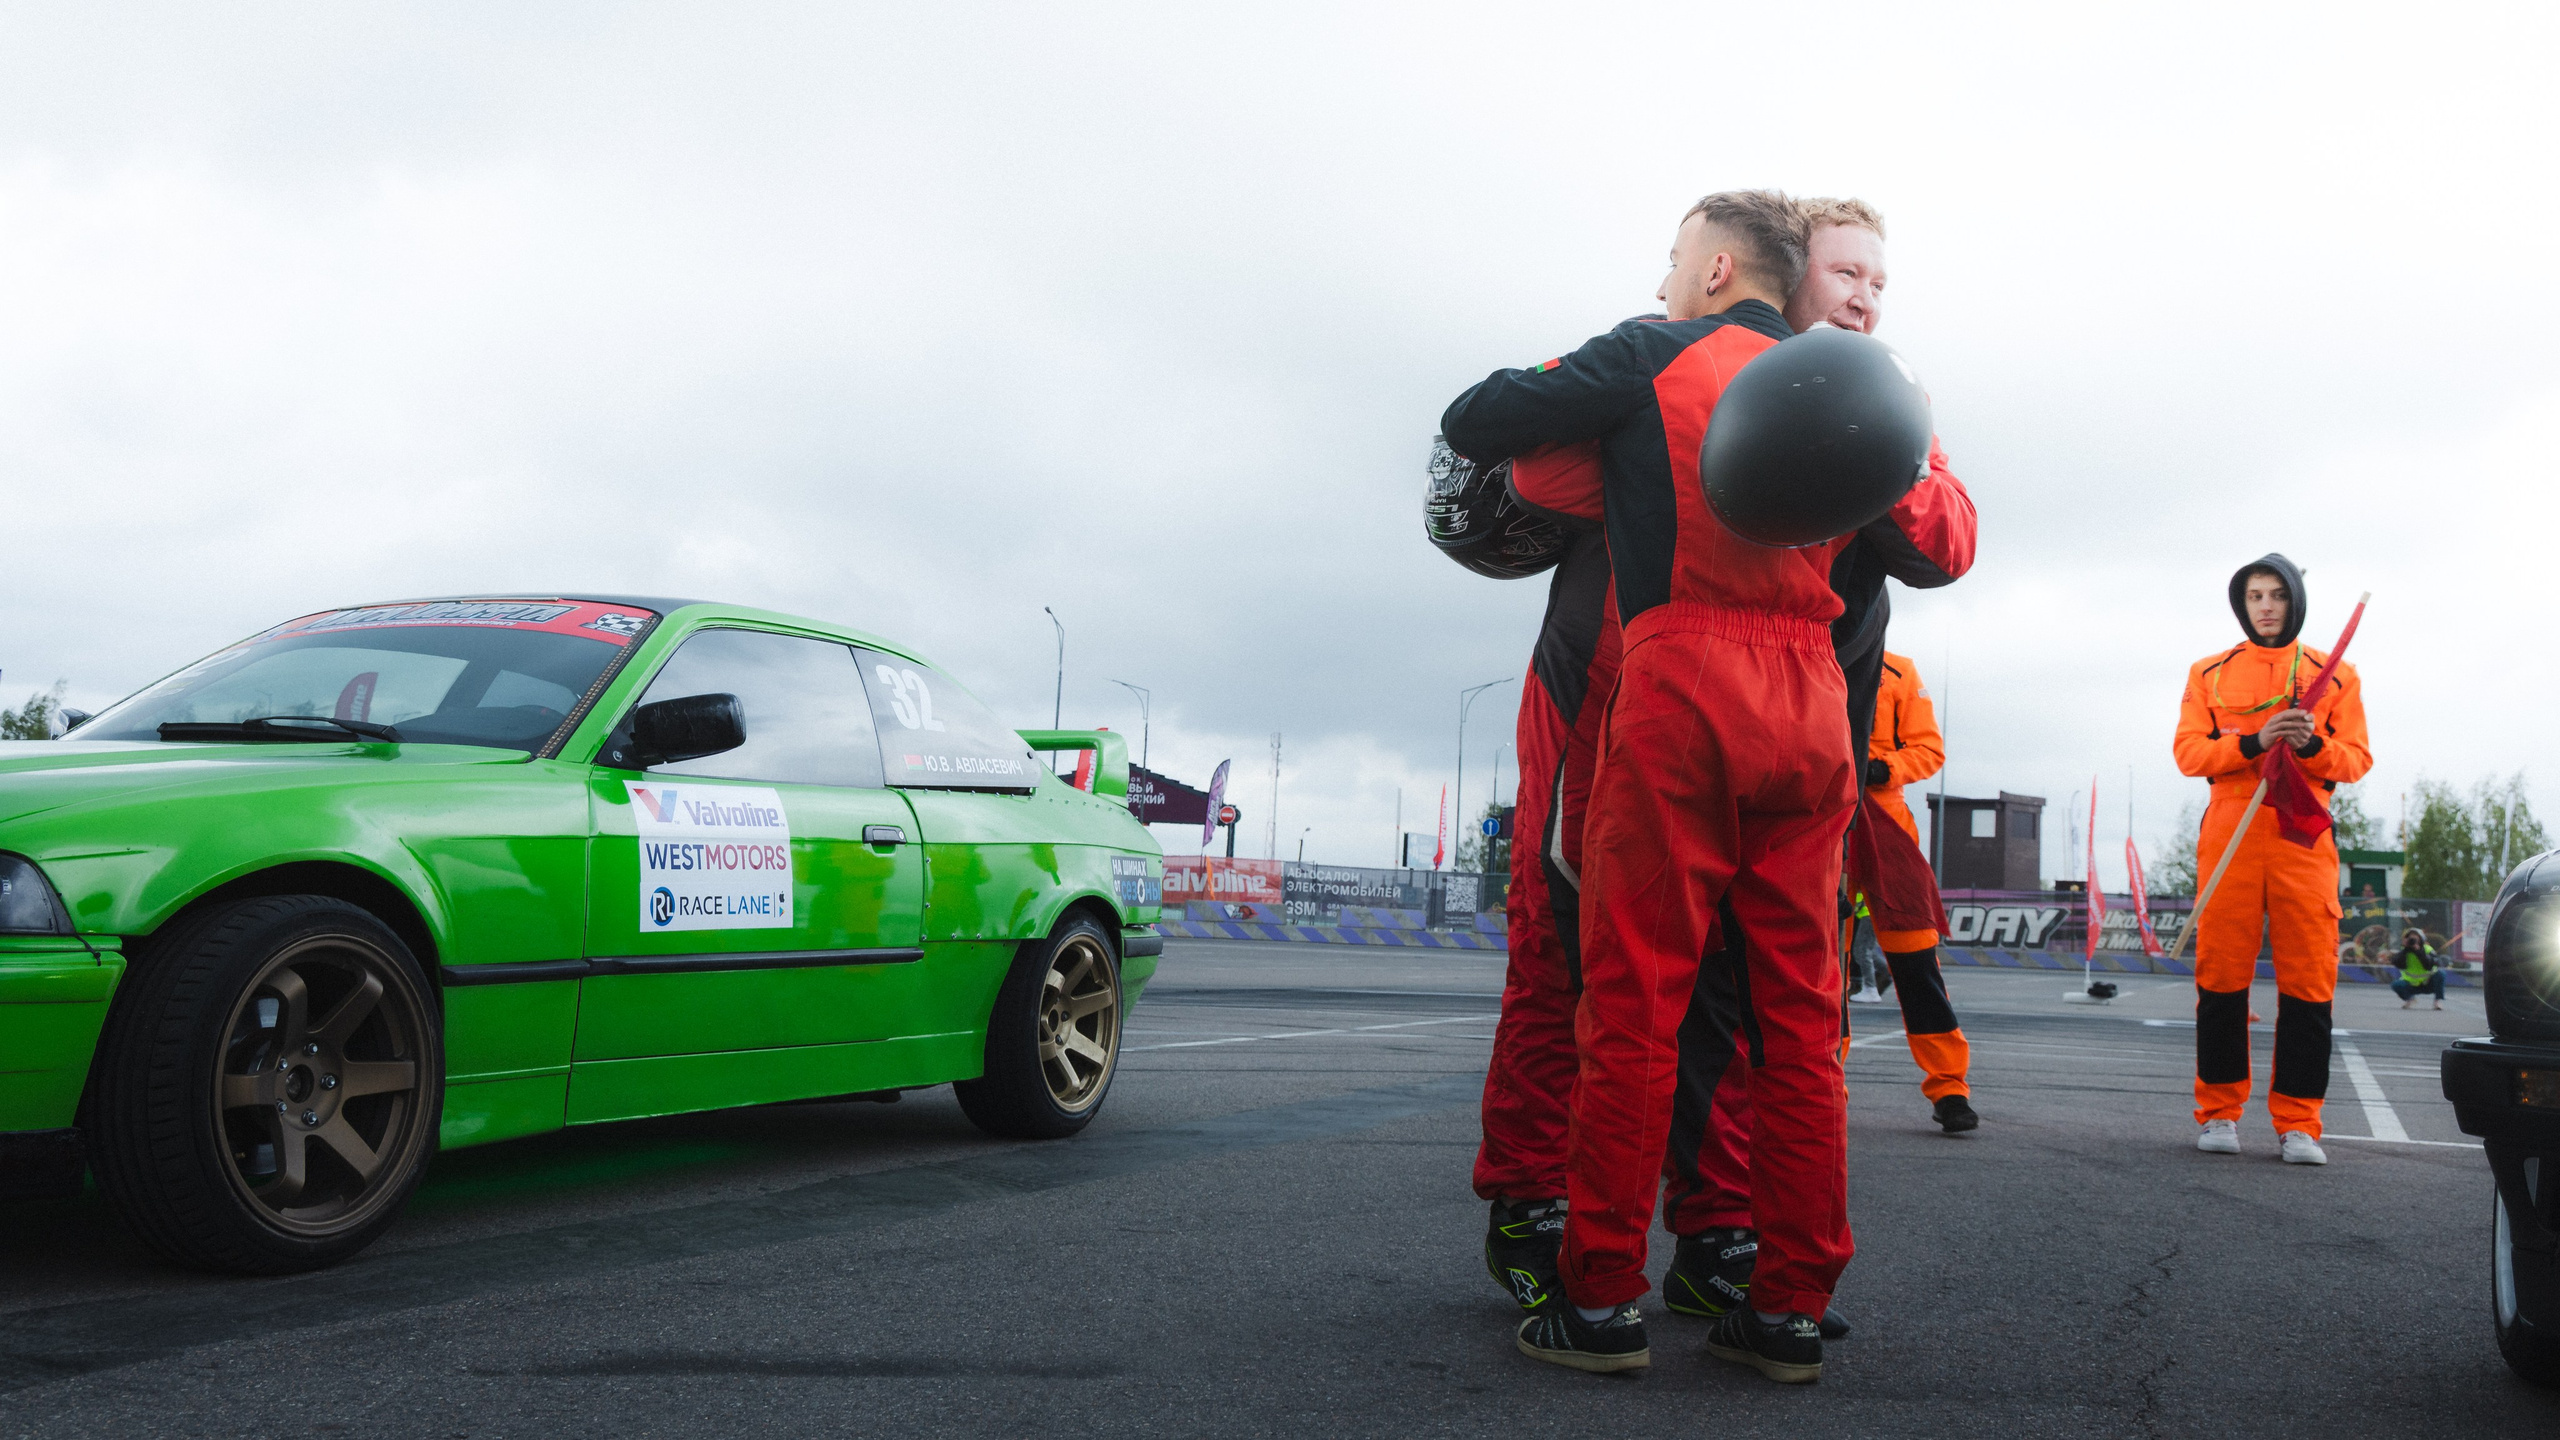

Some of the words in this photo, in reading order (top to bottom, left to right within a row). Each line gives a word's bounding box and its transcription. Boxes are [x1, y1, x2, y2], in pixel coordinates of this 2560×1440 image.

[875, 664, 946, 732] 32
[924, 755, 953, 772] Ю.В.
[955, 757, 1024, 775] АВЛАСЕВИЧ
[683, 800, 779, 827] Valvoline
[646, 843, 787, 870] WESTMOTORS
[1112, 859, 1122, 876] НА
[1123, 860, 1147, 877] ШИНАХ
[1287, 867, 1360, 882] АВТОСАЛОН
[1163, 867, 1268, 894] alvoline
[1286, 880, 1401, 899] ЭЛЕКТРОМОБИЛЕЙ
[679, 896, 723, 916] RACE
[727, 895, 770, 915] LANE
[1284, 900, 1316, 916] GSM
[1948, 905, 2063, 944] DAY
